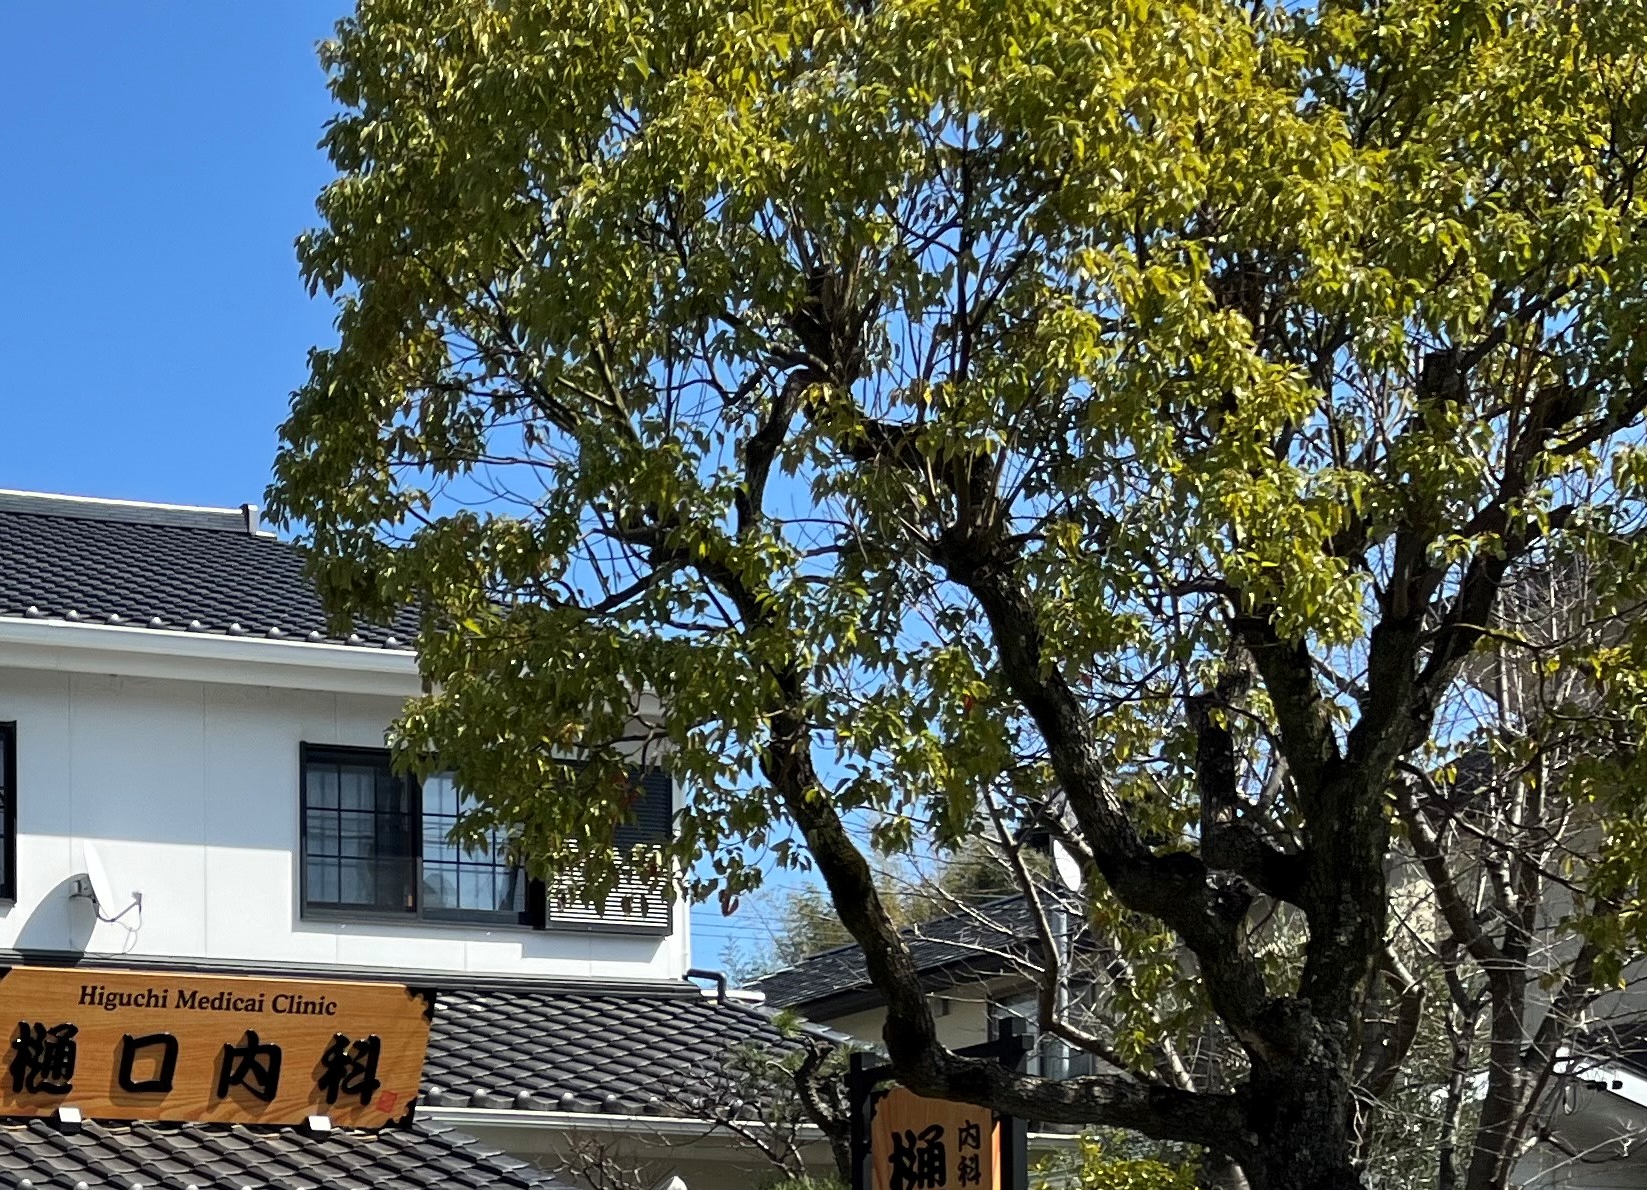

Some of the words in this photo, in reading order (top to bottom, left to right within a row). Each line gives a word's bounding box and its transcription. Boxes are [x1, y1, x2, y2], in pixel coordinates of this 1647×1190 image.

[78, 985, 168, 1011] Higuchi
[271, 994, 338, 1016] Clinic
[10, 1019, 382, 1107] 樋口内科
